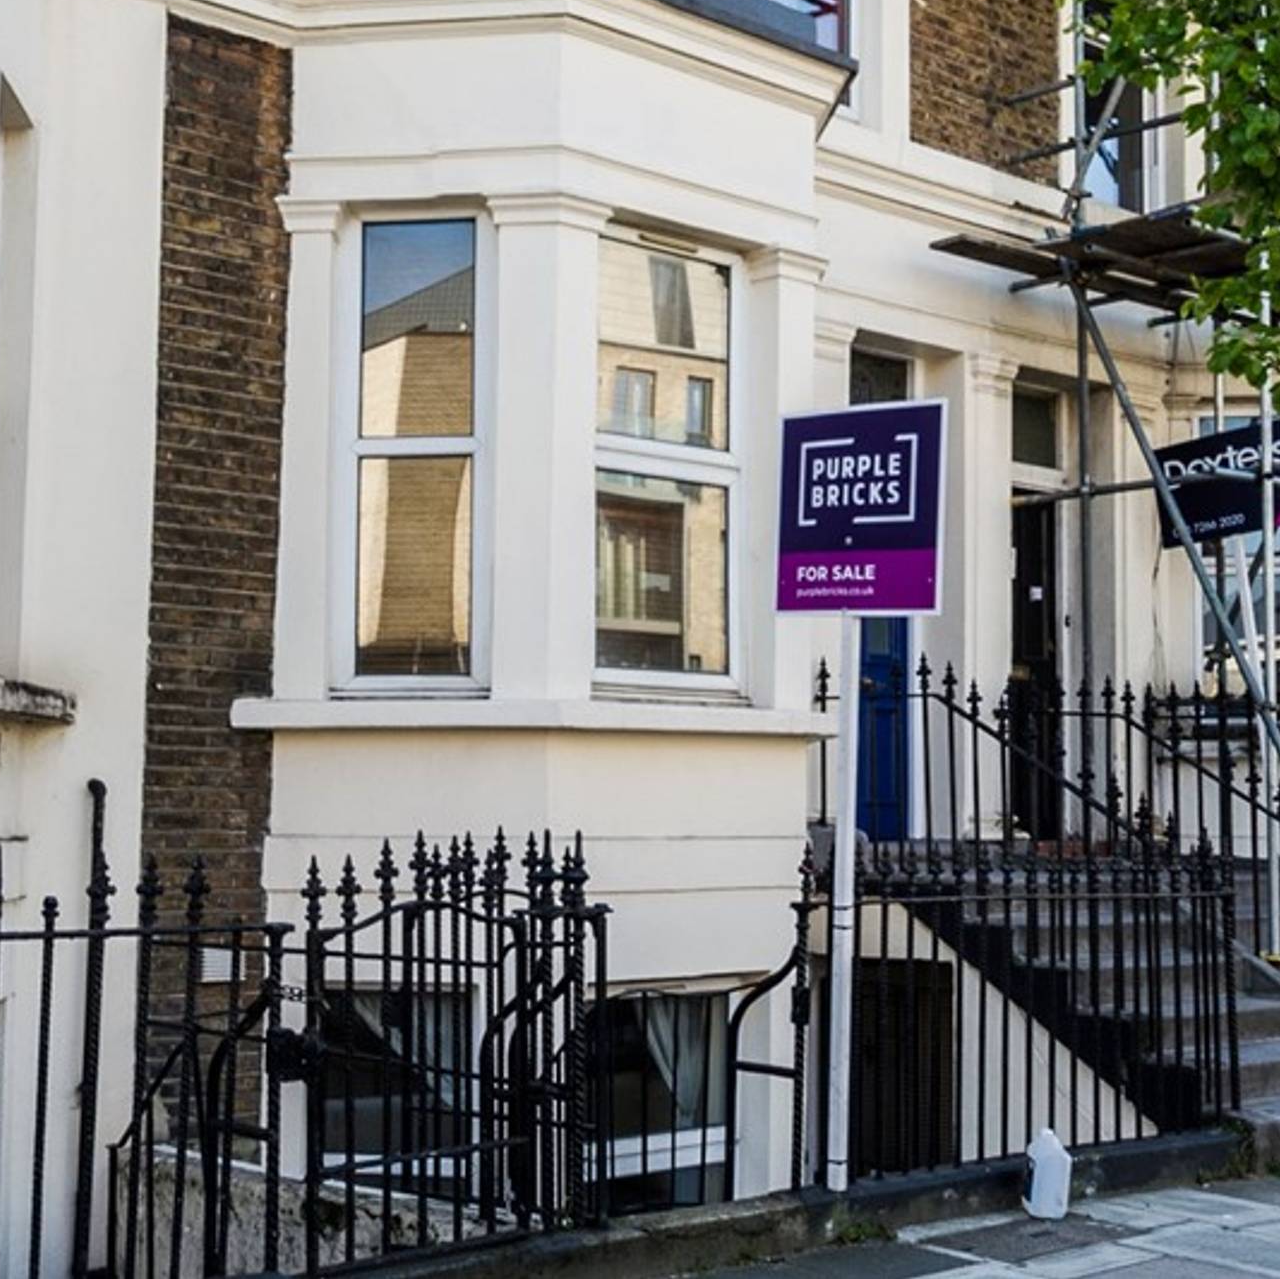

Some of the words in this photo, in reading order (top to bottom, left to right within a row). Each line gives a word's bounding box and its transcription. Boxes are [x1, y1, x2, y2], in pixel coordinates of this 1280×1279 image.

[812, 453, 902, 481] PURPLE
[811, 482, 901, 509] BRICKS
[797, 566, 828, 582] FOR
[832, 564, 876, 581] SALE
[796, 586, 874, 599] purplebricks.co.uk
